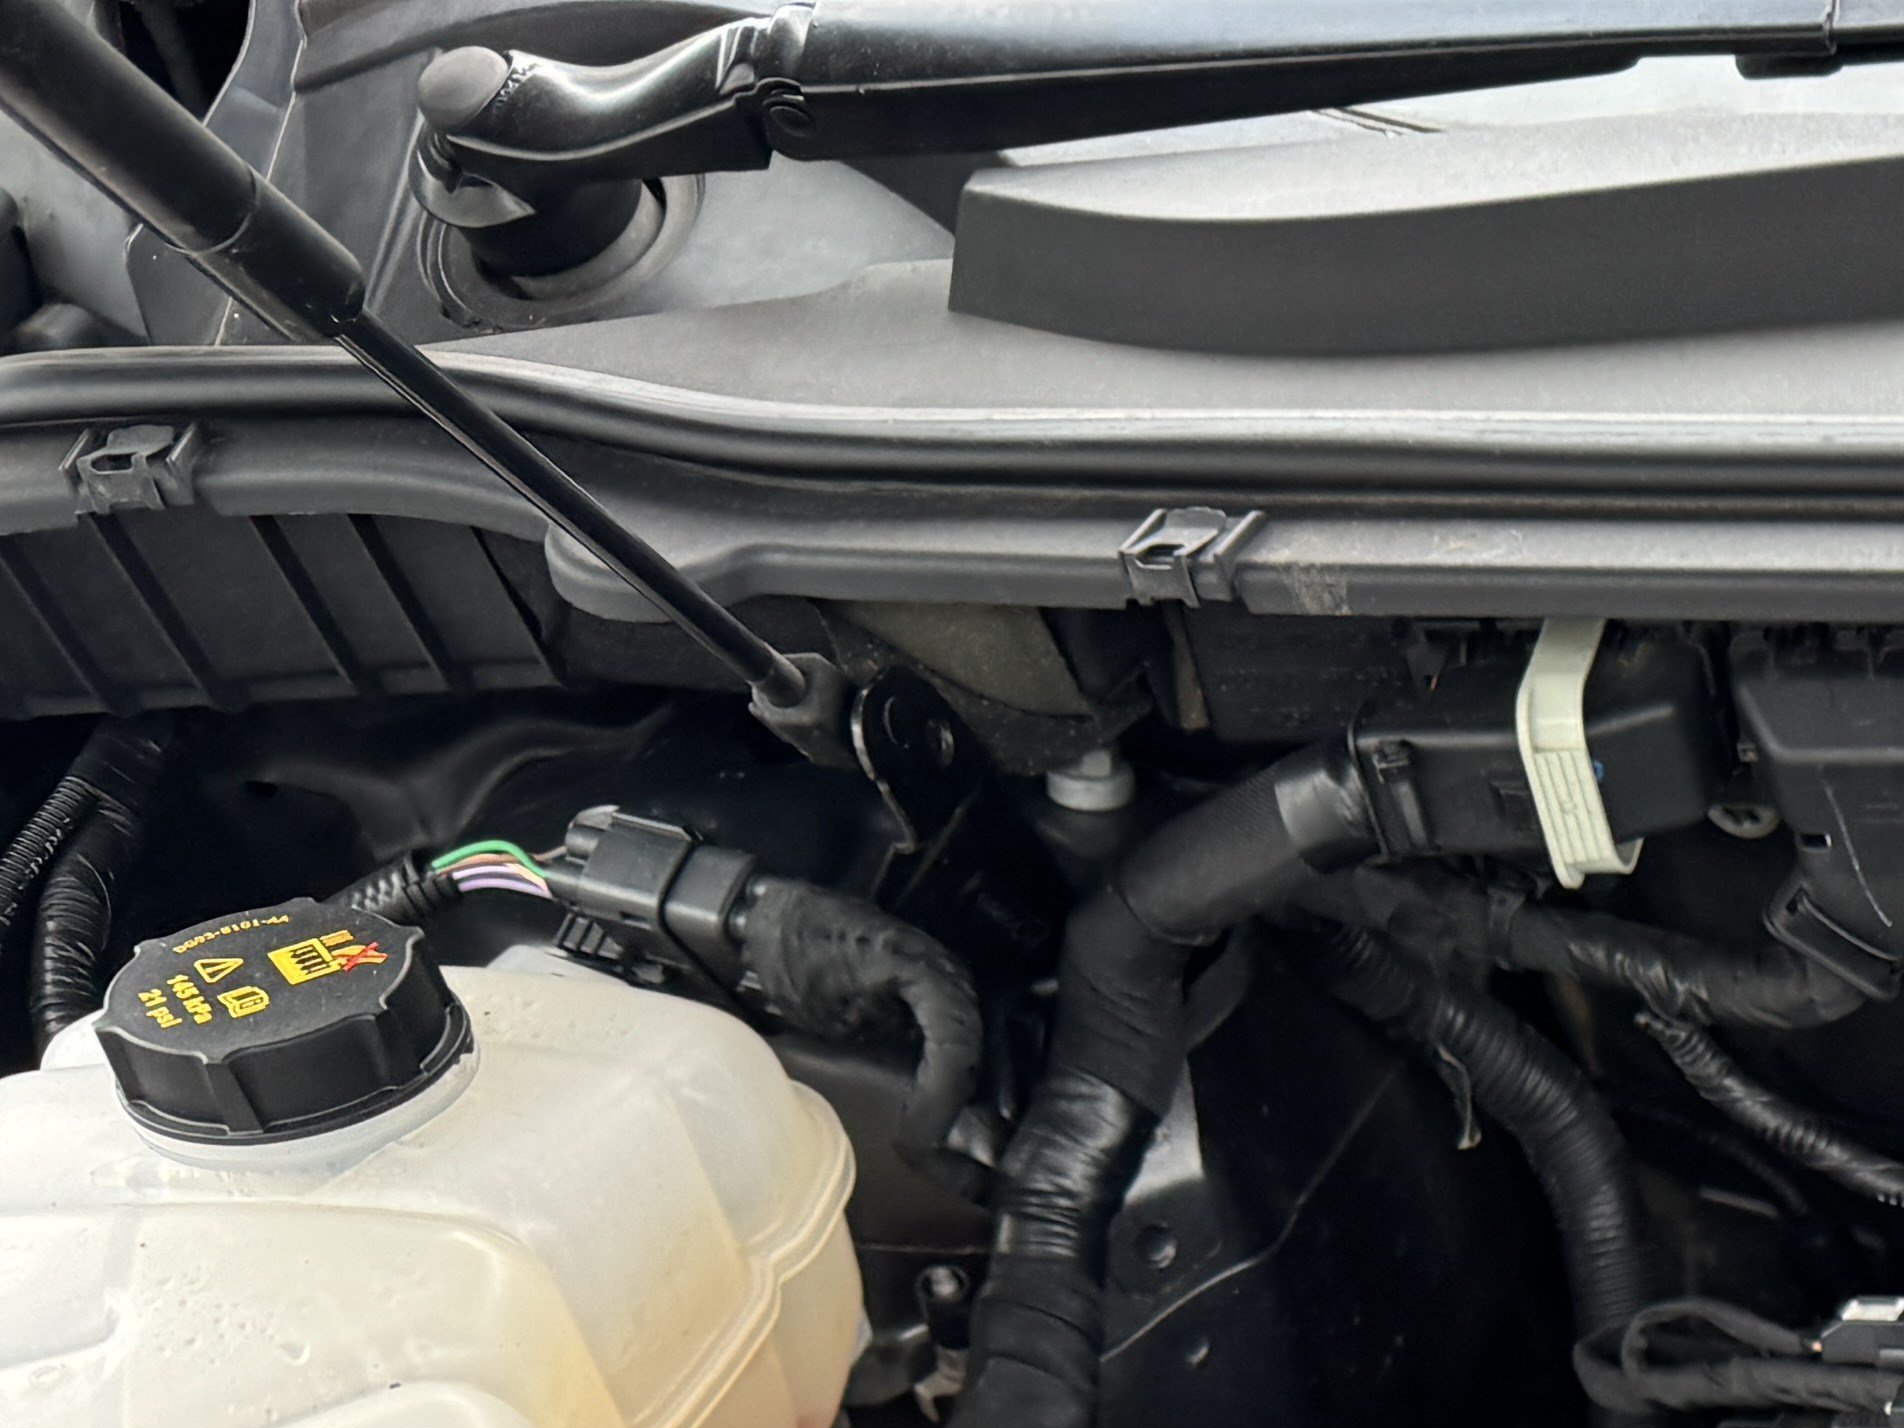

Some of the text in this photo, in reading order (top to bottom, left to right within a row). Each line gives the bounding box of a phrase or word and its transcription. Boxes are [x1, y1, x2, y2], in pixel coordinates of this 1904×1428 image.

[138, 988, 183, 1029] 21 psi
[166, 974, 213, 1024] 145 kPa
